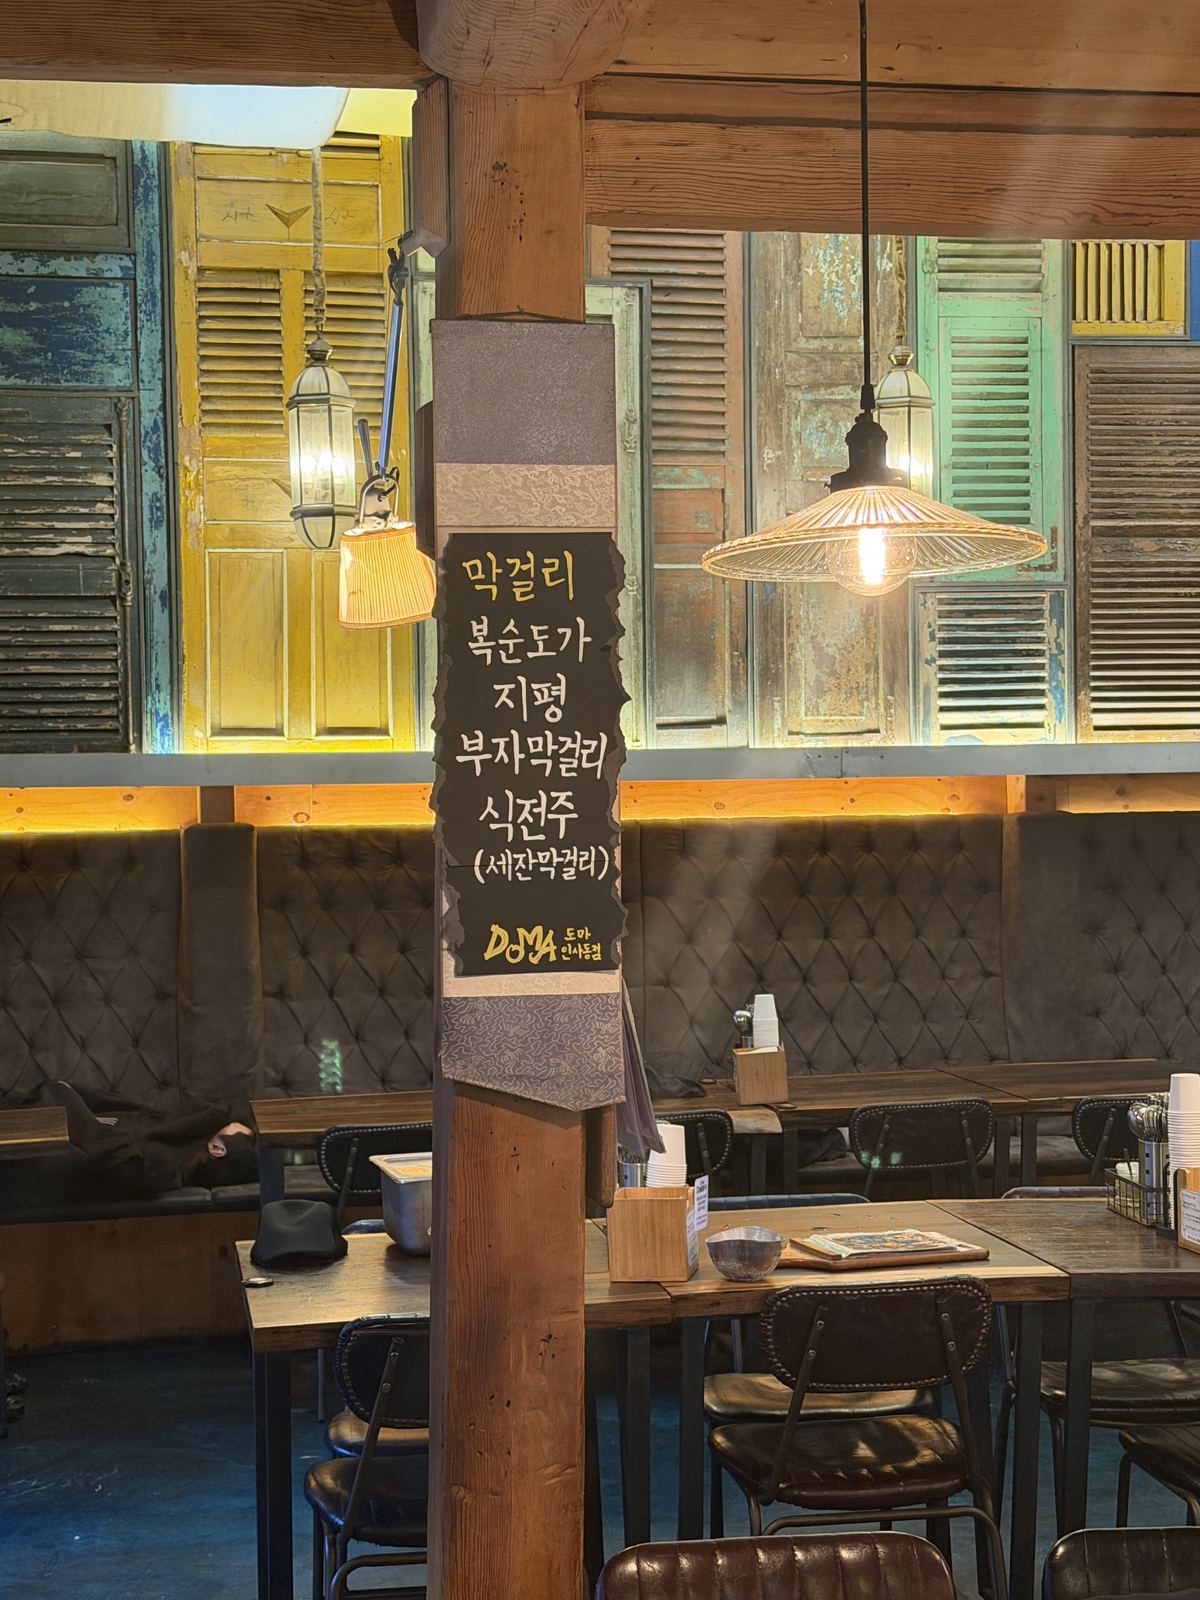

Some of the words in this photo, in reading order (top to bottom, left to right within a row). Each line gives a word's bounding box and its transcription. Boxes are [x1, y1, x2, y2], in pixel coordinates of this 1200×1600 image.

[461, 550, 574, 602] 막걸리
[467, 615, 593, 666] 복순도가
[493, 672, 567, 723] 지평
[455, 729, 608, 780] 부자막걸리
[478, 789, 579, 842] 식전주
[473, 845, 610, 884] (세잔막걸리)
[560, 942, 602, 961] 인사동점
[563, 926, 592, 941] 도마
